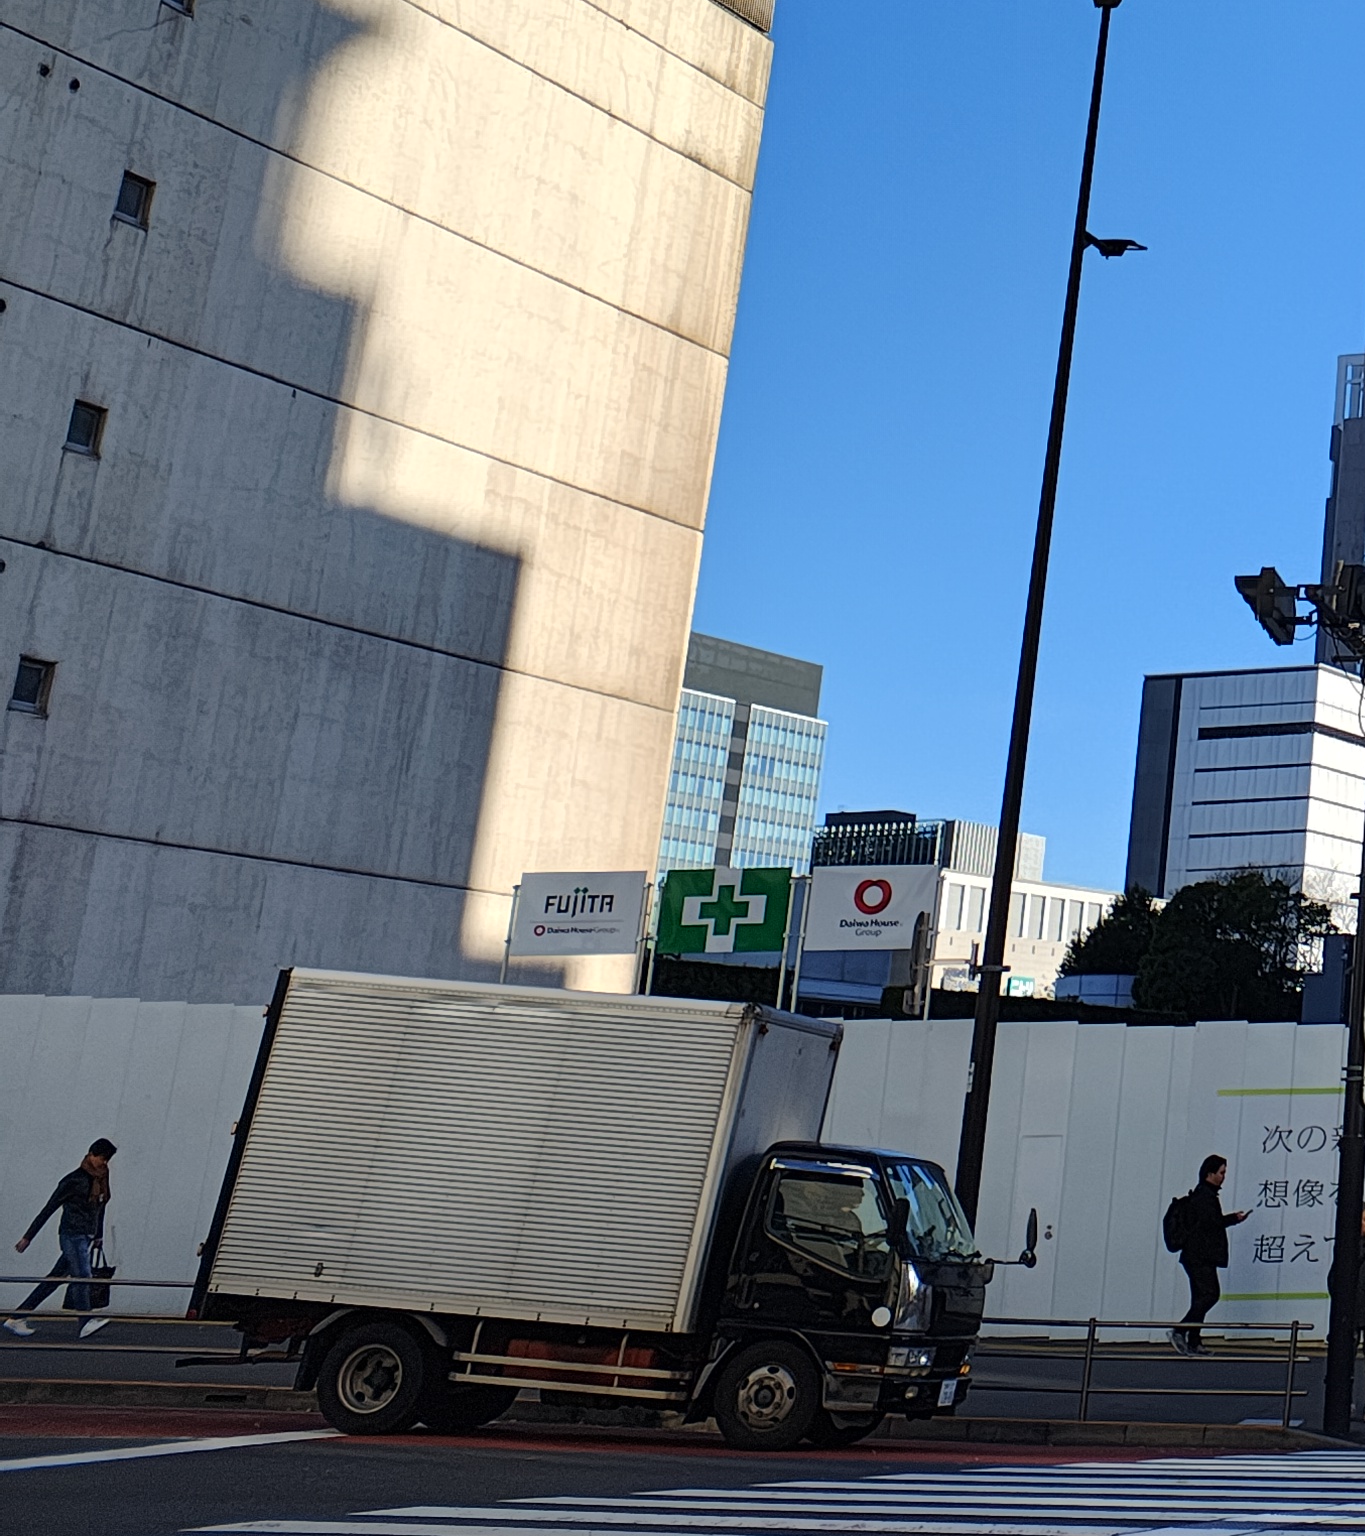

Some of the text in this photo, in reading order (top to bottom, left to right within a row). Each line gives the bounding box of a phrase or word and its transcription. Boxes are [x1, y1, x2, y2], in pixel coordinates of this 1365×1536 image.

[544, 887, 614, 918] FUJITA
[839, 919, 900, 928] Daiwa House
[855, 928, 882, 937] Group
